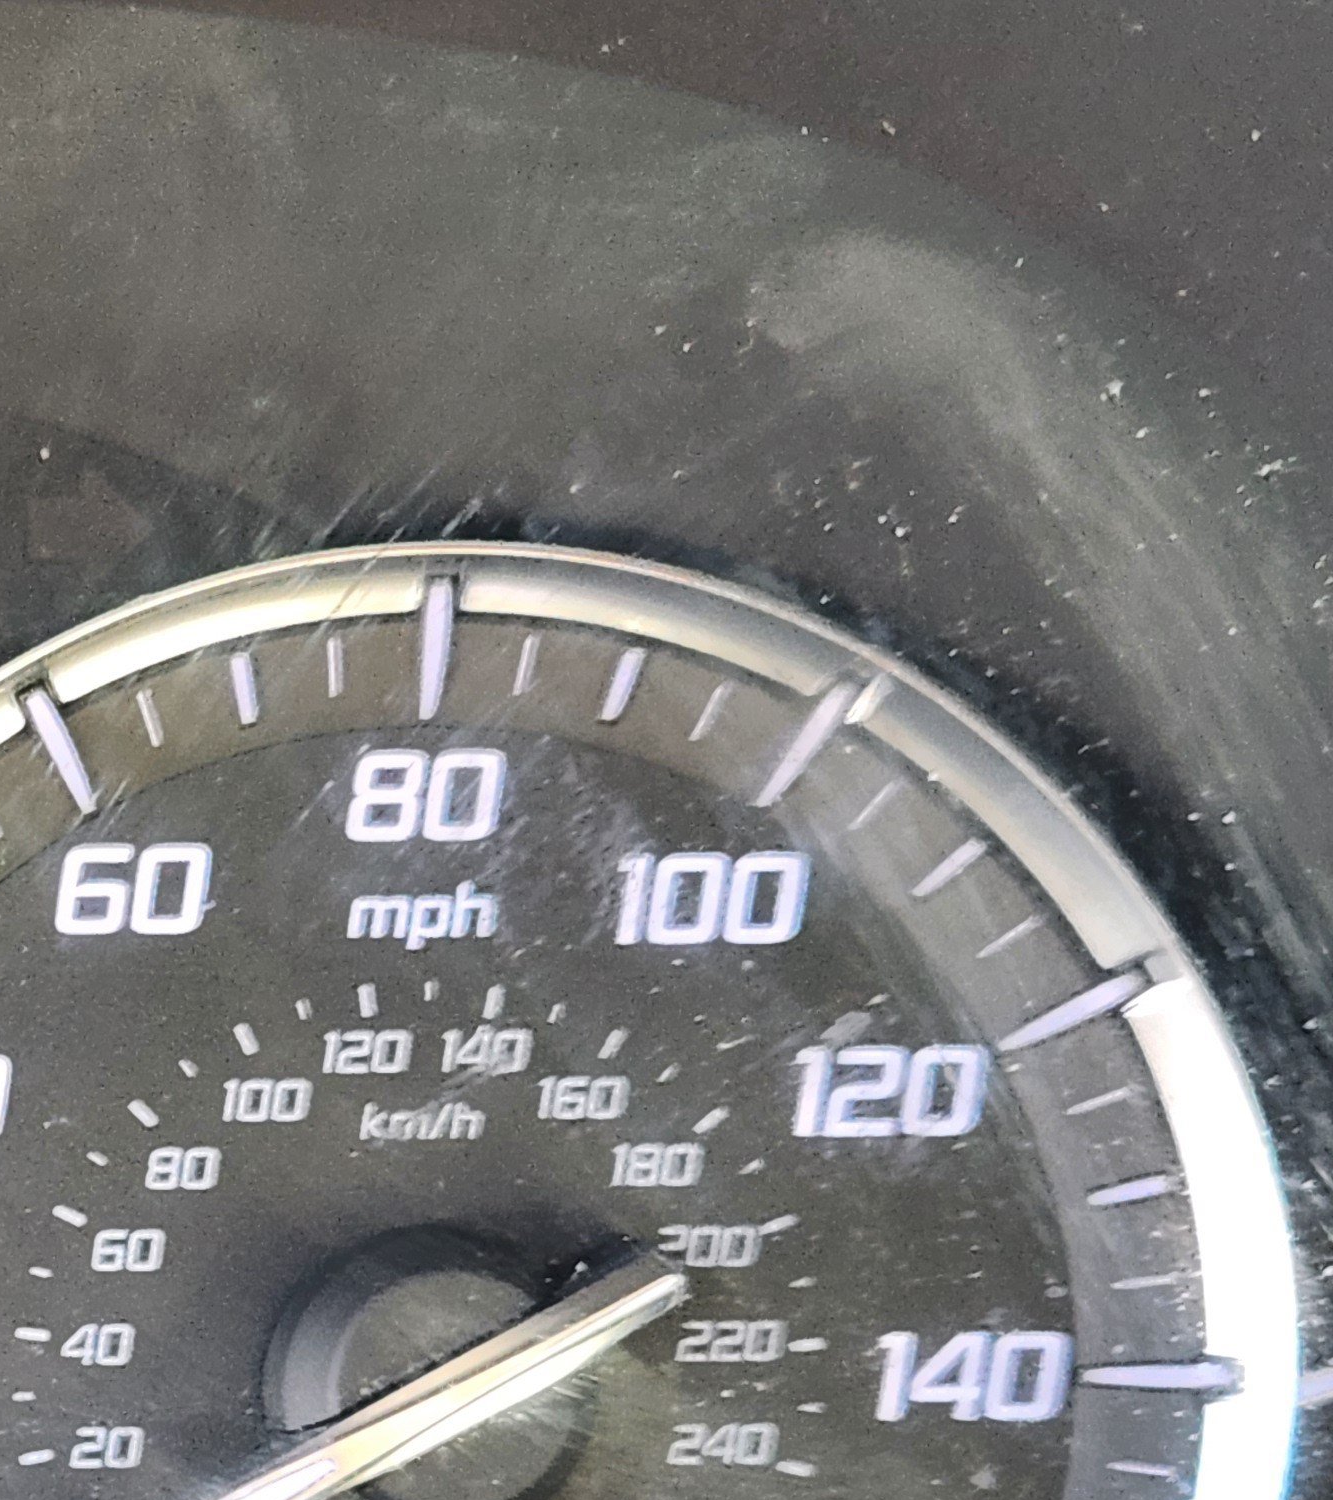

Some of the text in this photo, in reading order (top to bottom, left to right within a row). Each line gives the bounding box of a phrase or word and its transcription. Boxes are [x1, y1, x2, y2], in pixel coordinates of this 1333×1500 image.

[346, 748, 506, 842] 80
[55, 843, 213, 935] 60
[615, 849, 810, 945] 100
[347, 880, 499, 950] mph
[322, 1030, 413, 1074] 120
[441, 1029, 532, 1075] 140
[222, 1078, 312, 1122] 100
[538, 1076, 630, 1120] 160
[792, 1044, 988, 1137] 120
[359, 1102, 485, 1140] km/h
[145, 1147, 221, 1190] 80
[610, 1143, 704, 1187] 180
[91, 1229, 166, 1272] 60
[61, 1323, 135, 1366] 40
[674, 1319, 786, 1362] 220
[875, 1329, 1069, 1422] 140
[69, 1426, 144, 1469] 20
[666, 1423, 778, 1465] 240
